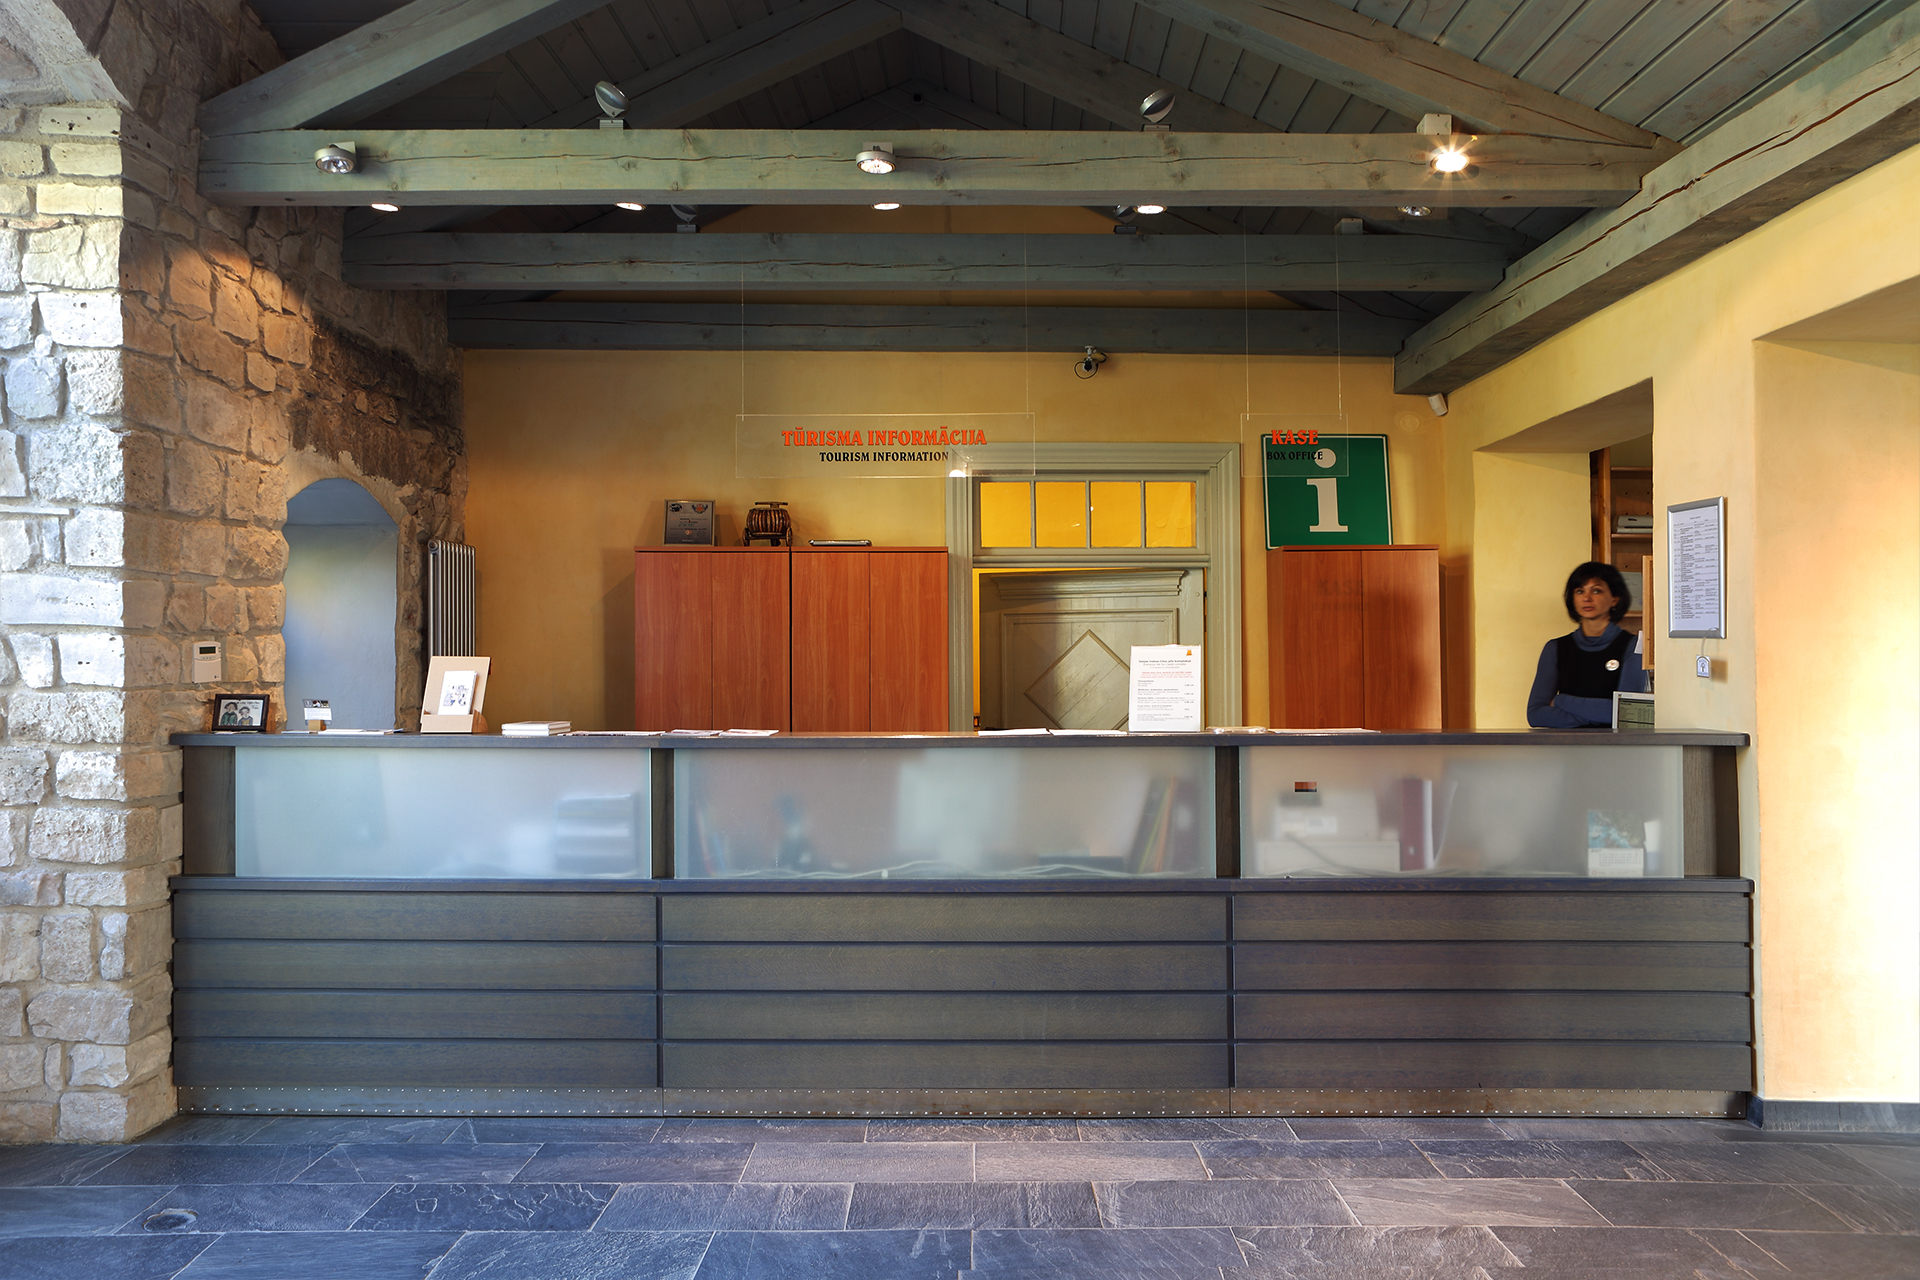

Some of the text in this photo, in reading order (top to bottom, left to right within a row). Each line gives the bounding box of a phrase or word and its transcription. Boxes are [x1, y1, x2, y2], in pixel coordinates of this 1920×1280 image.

[781, 426, 987, 446] TŪRISMA INFORMĀCIJA
[1271, 429, 1319, 445] KASE
[819, 451, 949, 462] TOURISM INFORMATION
[1267, 451, 1324, 460] BOX OFFICE
